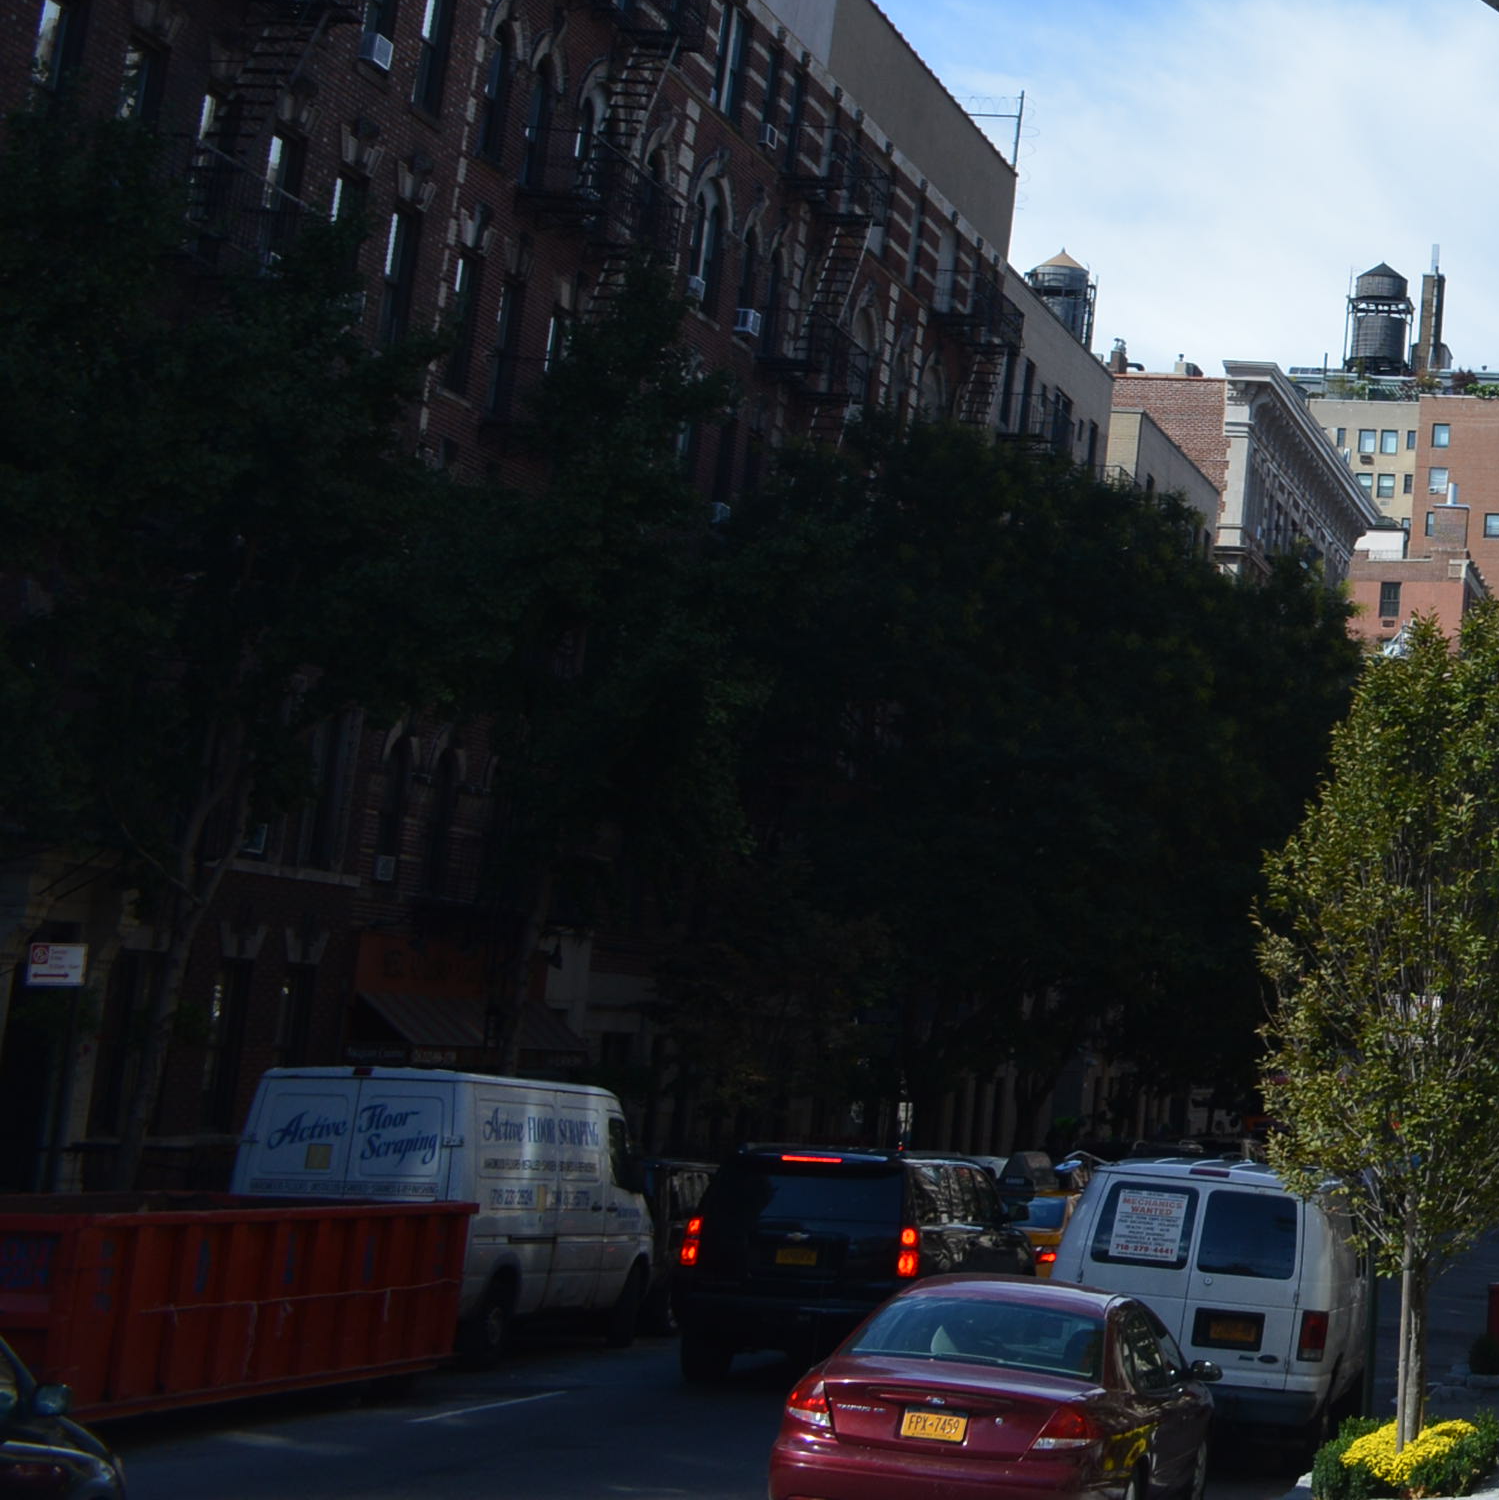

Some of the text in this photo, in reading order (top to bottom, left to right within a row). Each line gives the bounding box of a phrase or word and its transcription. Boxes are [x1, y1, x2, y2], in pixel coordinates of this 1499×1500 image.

[267, 1103, 419, 1150] Active Floor
[483, 1107, 599, 1146] Active FLOOR SCRAPING
[360, 1129, 438, 1168] Scraping
[1122, 1197, 1184, 1209] MECHANICS
[1130, 1205, 1173, 1216] WANTED
